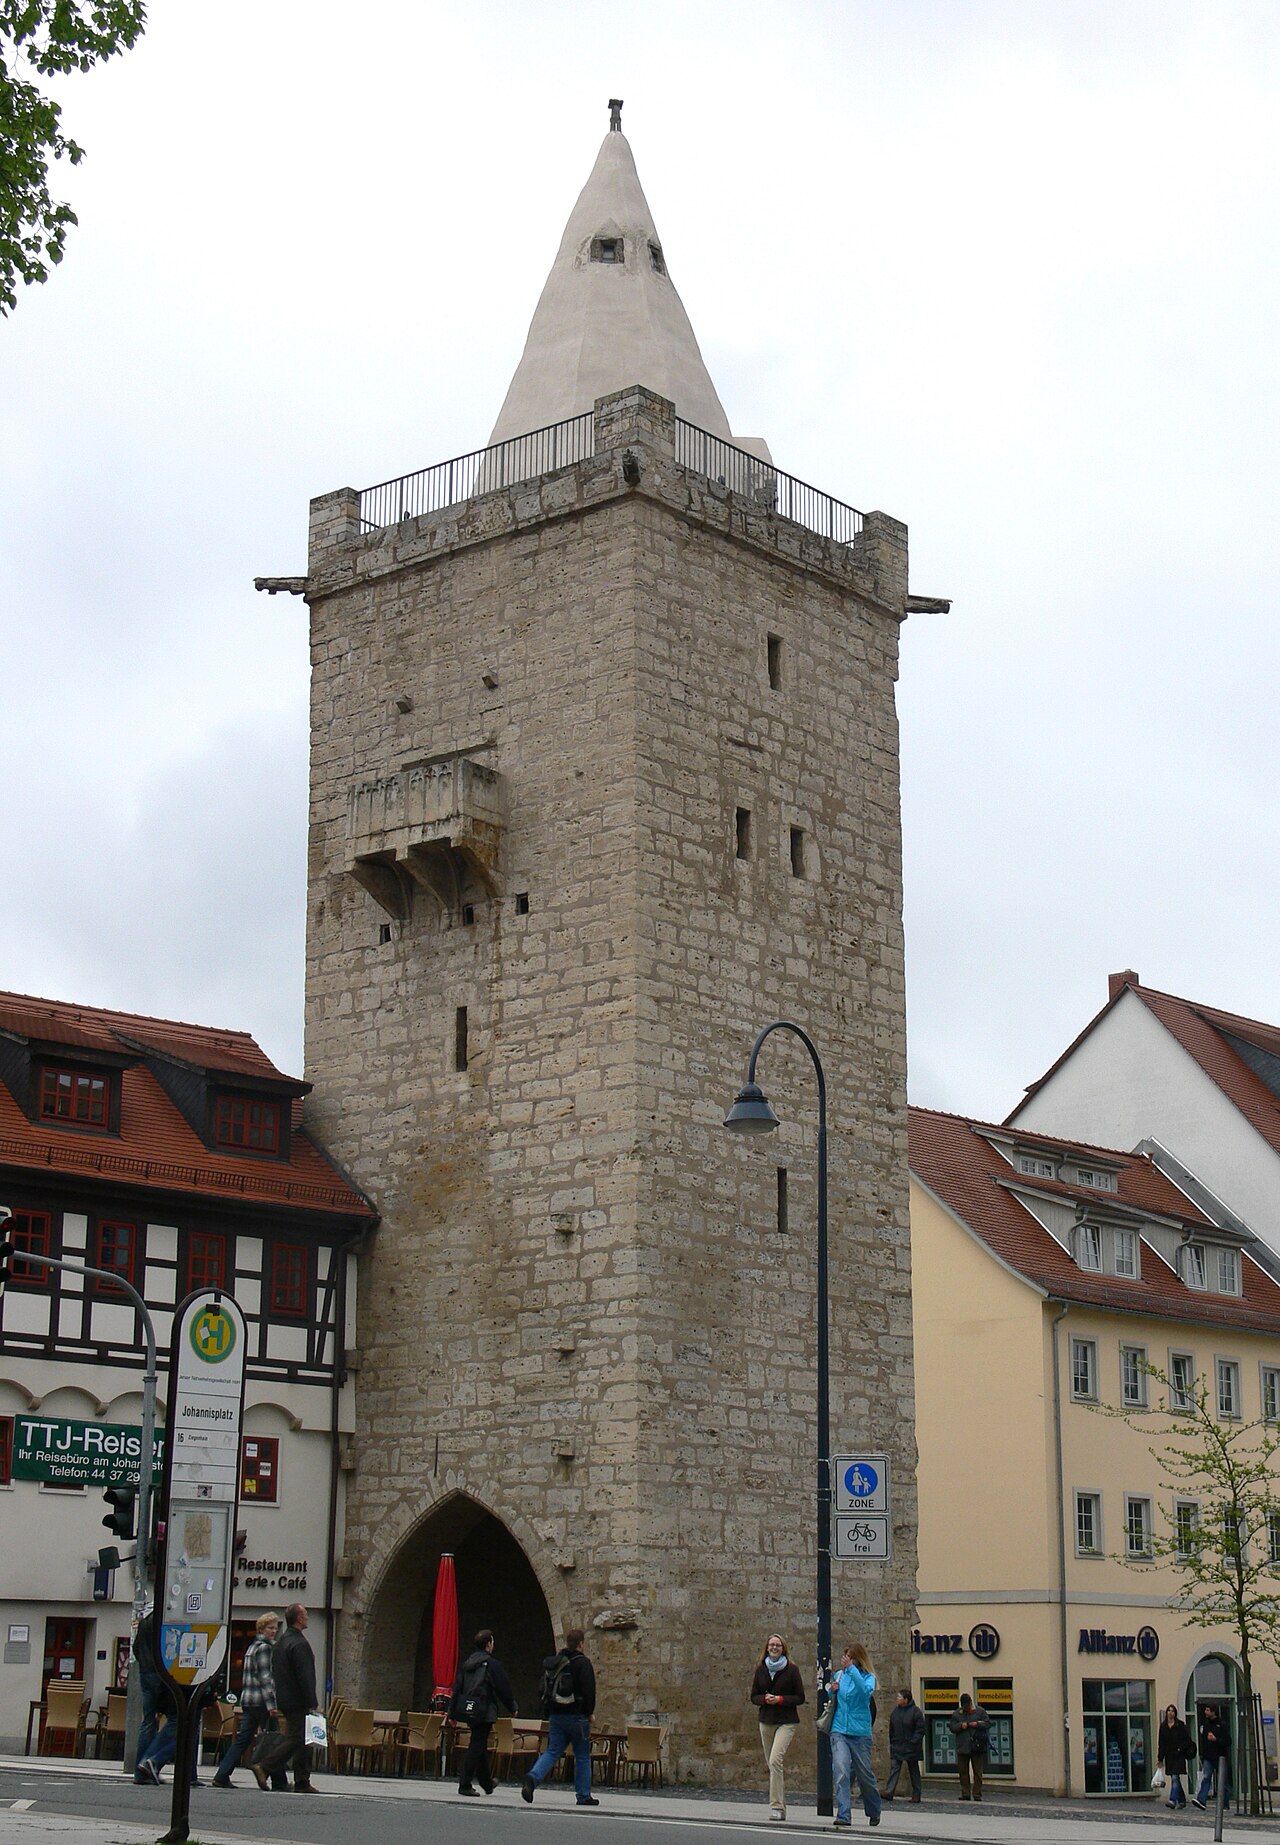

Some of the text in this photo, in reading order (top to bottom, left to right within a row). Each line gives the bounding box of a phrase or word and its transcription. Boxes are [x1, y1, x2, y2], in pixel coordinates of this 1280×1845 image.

[182, 1405, 233, 1421] Johannisplatz
[177, 1432, 184, 1443] 16
[18, 1448, 31, 1459] Ihr
[35, 1450, 90, 1465] Reisebüro
[93, 1458, 109, 1467] am
[50, 1465, 141, 1482] Telefon: 44 37 29
[848, 1499, 874, 1508] ZONE
[854, 1543, 871, 1553] frei
[238, 1557, 308, 1573] Restaurant
[278, 1575, 307, 1590] Café
[911, 1629, 963, 1653] ianz
[1078, 1629, 1136, 1653] Allianz
[925, 1691, 958, 1699] Immobilien
